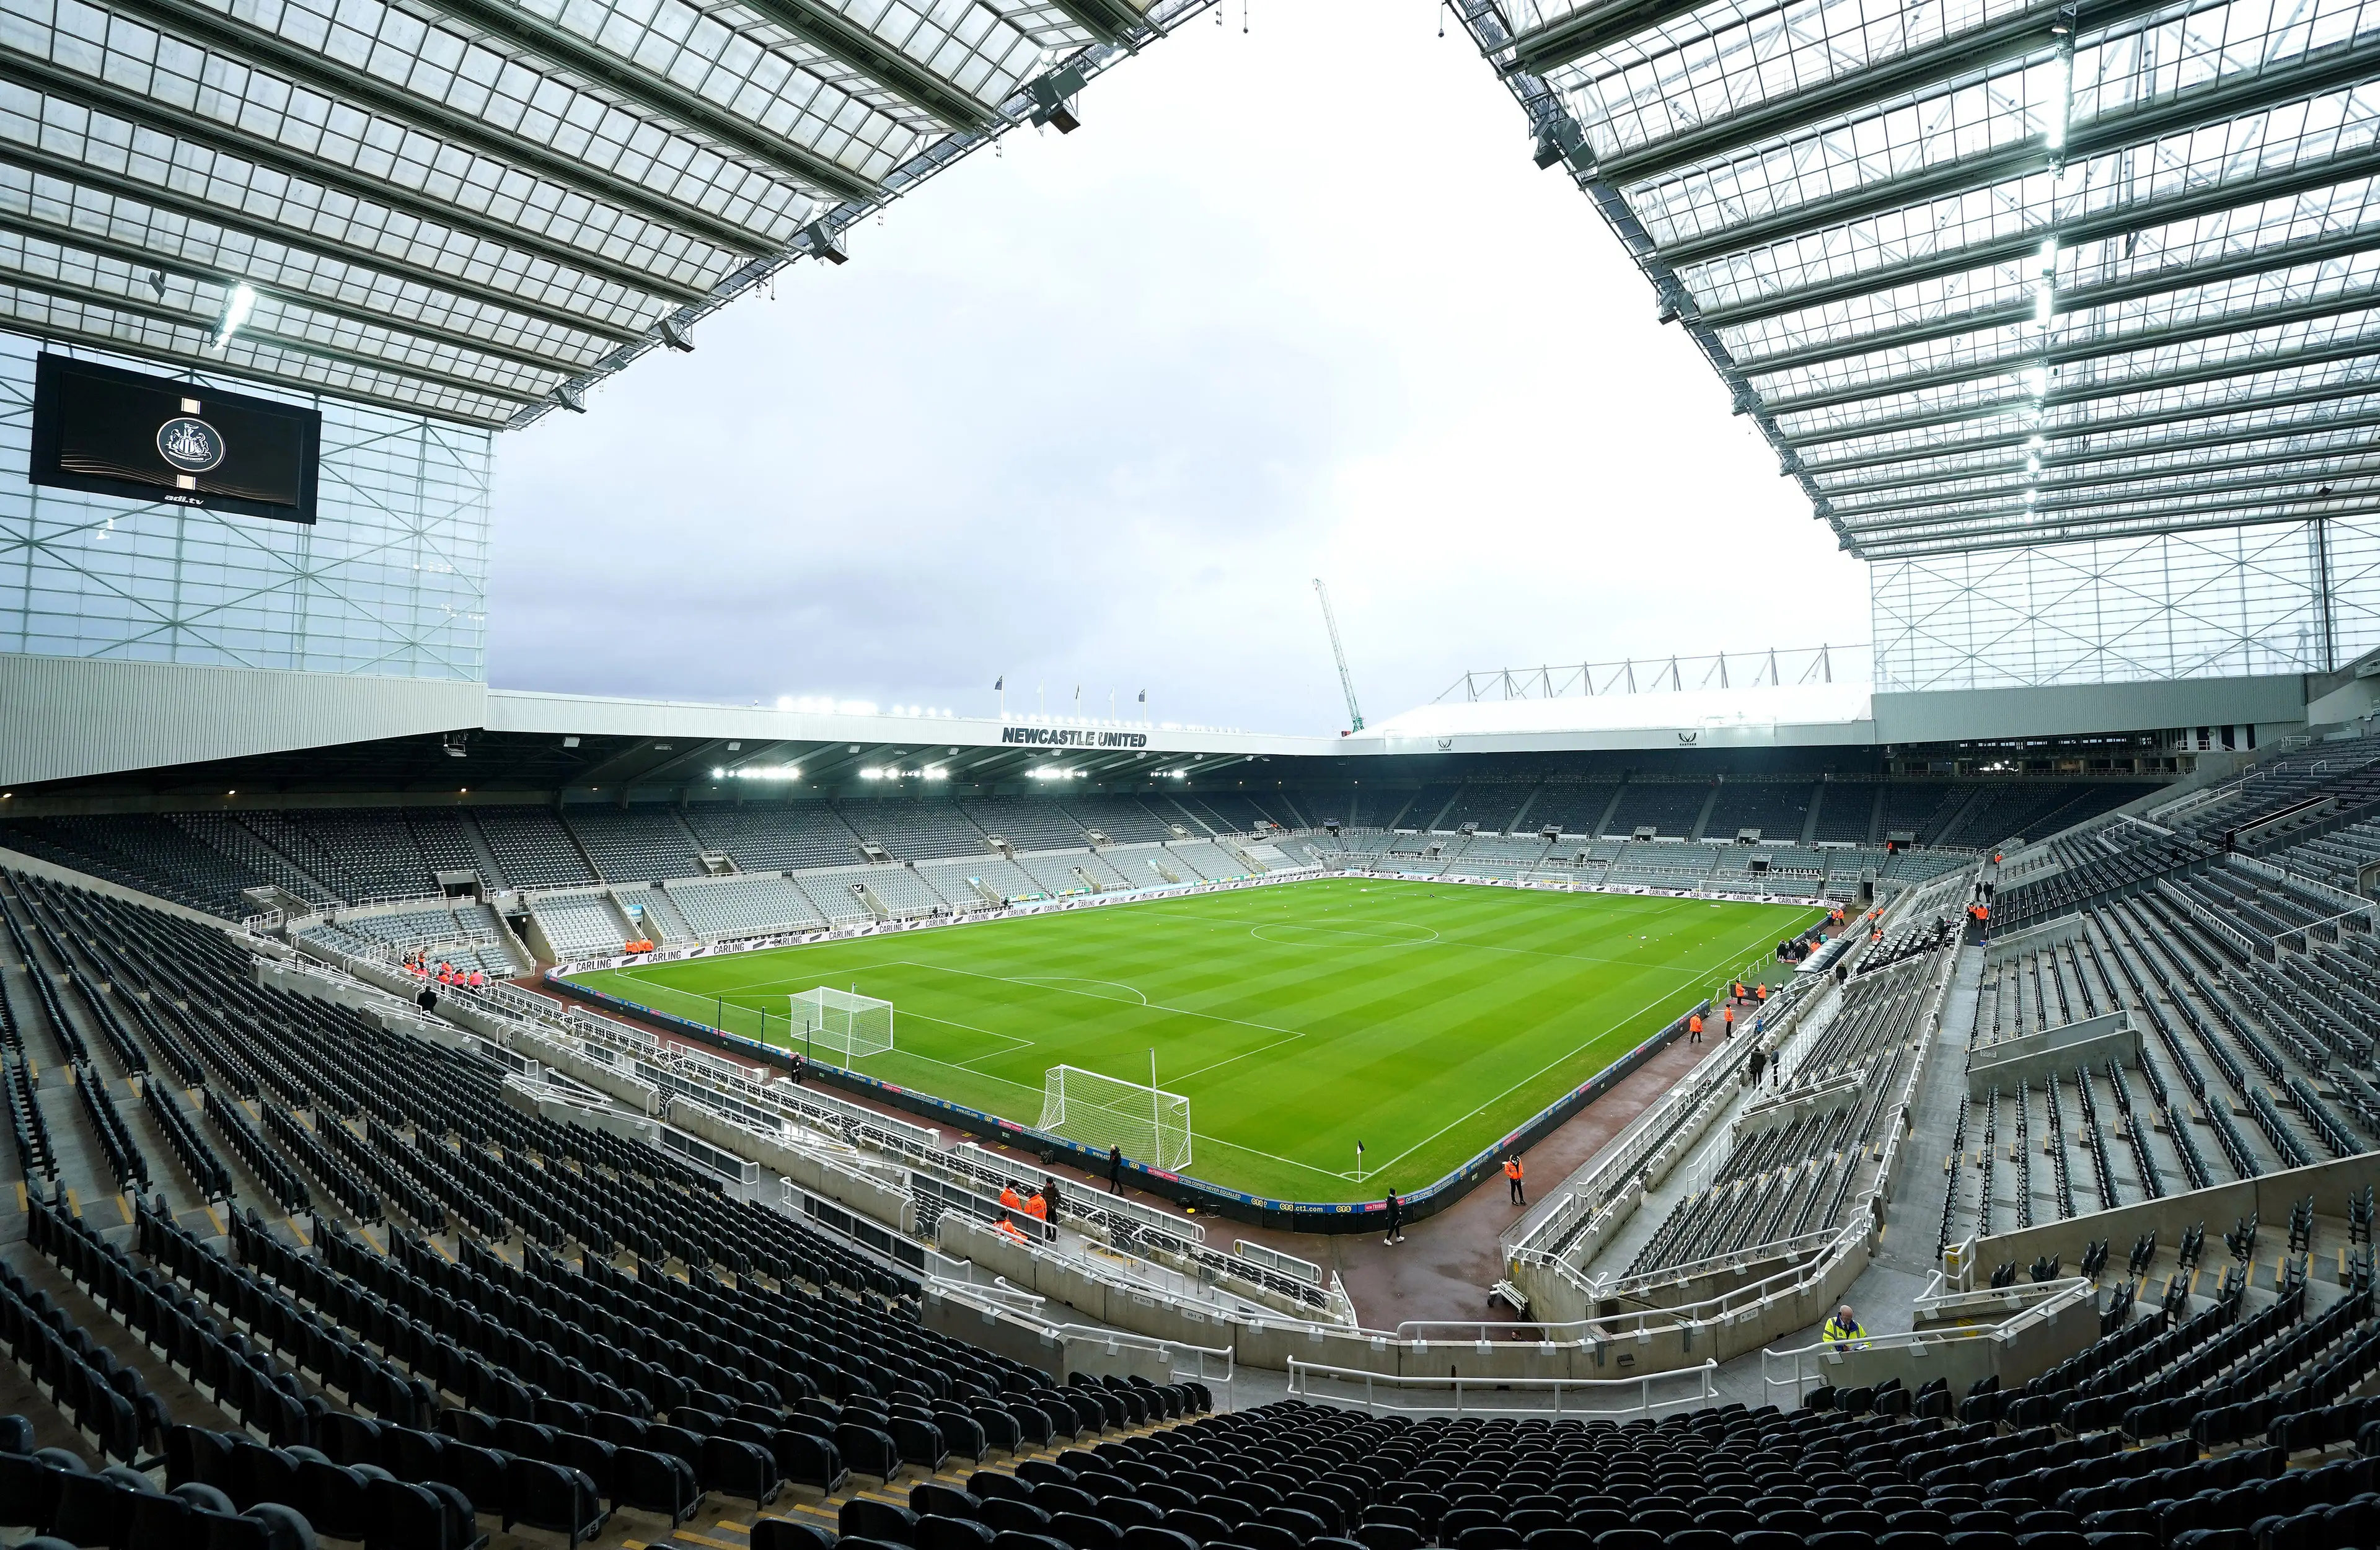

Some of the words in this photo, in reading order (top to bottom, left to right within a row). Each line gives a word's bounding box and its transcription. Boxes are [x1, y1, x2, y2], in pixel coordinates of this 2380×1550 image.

[164, 495, 204, 505] adi.tv
[1002, 727, 1095, 746] NEWCASTLE
[1098, 732, 1147, 747] UNITED
[1140, 892, 1155, 900] CARLING
[1168, 889, 1181, 897] CARLING
[1690, 891, 1712, 899] CARLING
[1078, 900, 1095, 909] CARLING
[1778, 897, 1802, 905] CARLING
[1823, 900, 1840, 909] CARLING
[1008, 909, 1026, 917] CARLING
[1044, 904, 1062, 912] CARLING
[968, 913, 989, 922] CARLING
[879, 922, 903, 933] CARLING
[925, 918, 948, 928] CARLING
[829, 929, 855, 940] CARLING
[774, 936, 802, 947] CARLING
[713, 943, 744, 955] CARLING
[647, 950, 681, 963] CARLING
[576, 959, 612, 972] CARLING
[956, 1107, 979, 1118] www.ct1.com
[1092, 1151, 1111, 1161] www.ct1
[1179, 1177, 1191, 1185] OFTEN
[1191, 1181, 1206, 1189] COPIED
[1206, 1184, 1220, 1193] NEVER
[1220, 1188, 1241, 1199] EQUALLED
[1419, 1189, 1432, 1199] COPIED
[1279, 1202, 1294, 1211] CT1
